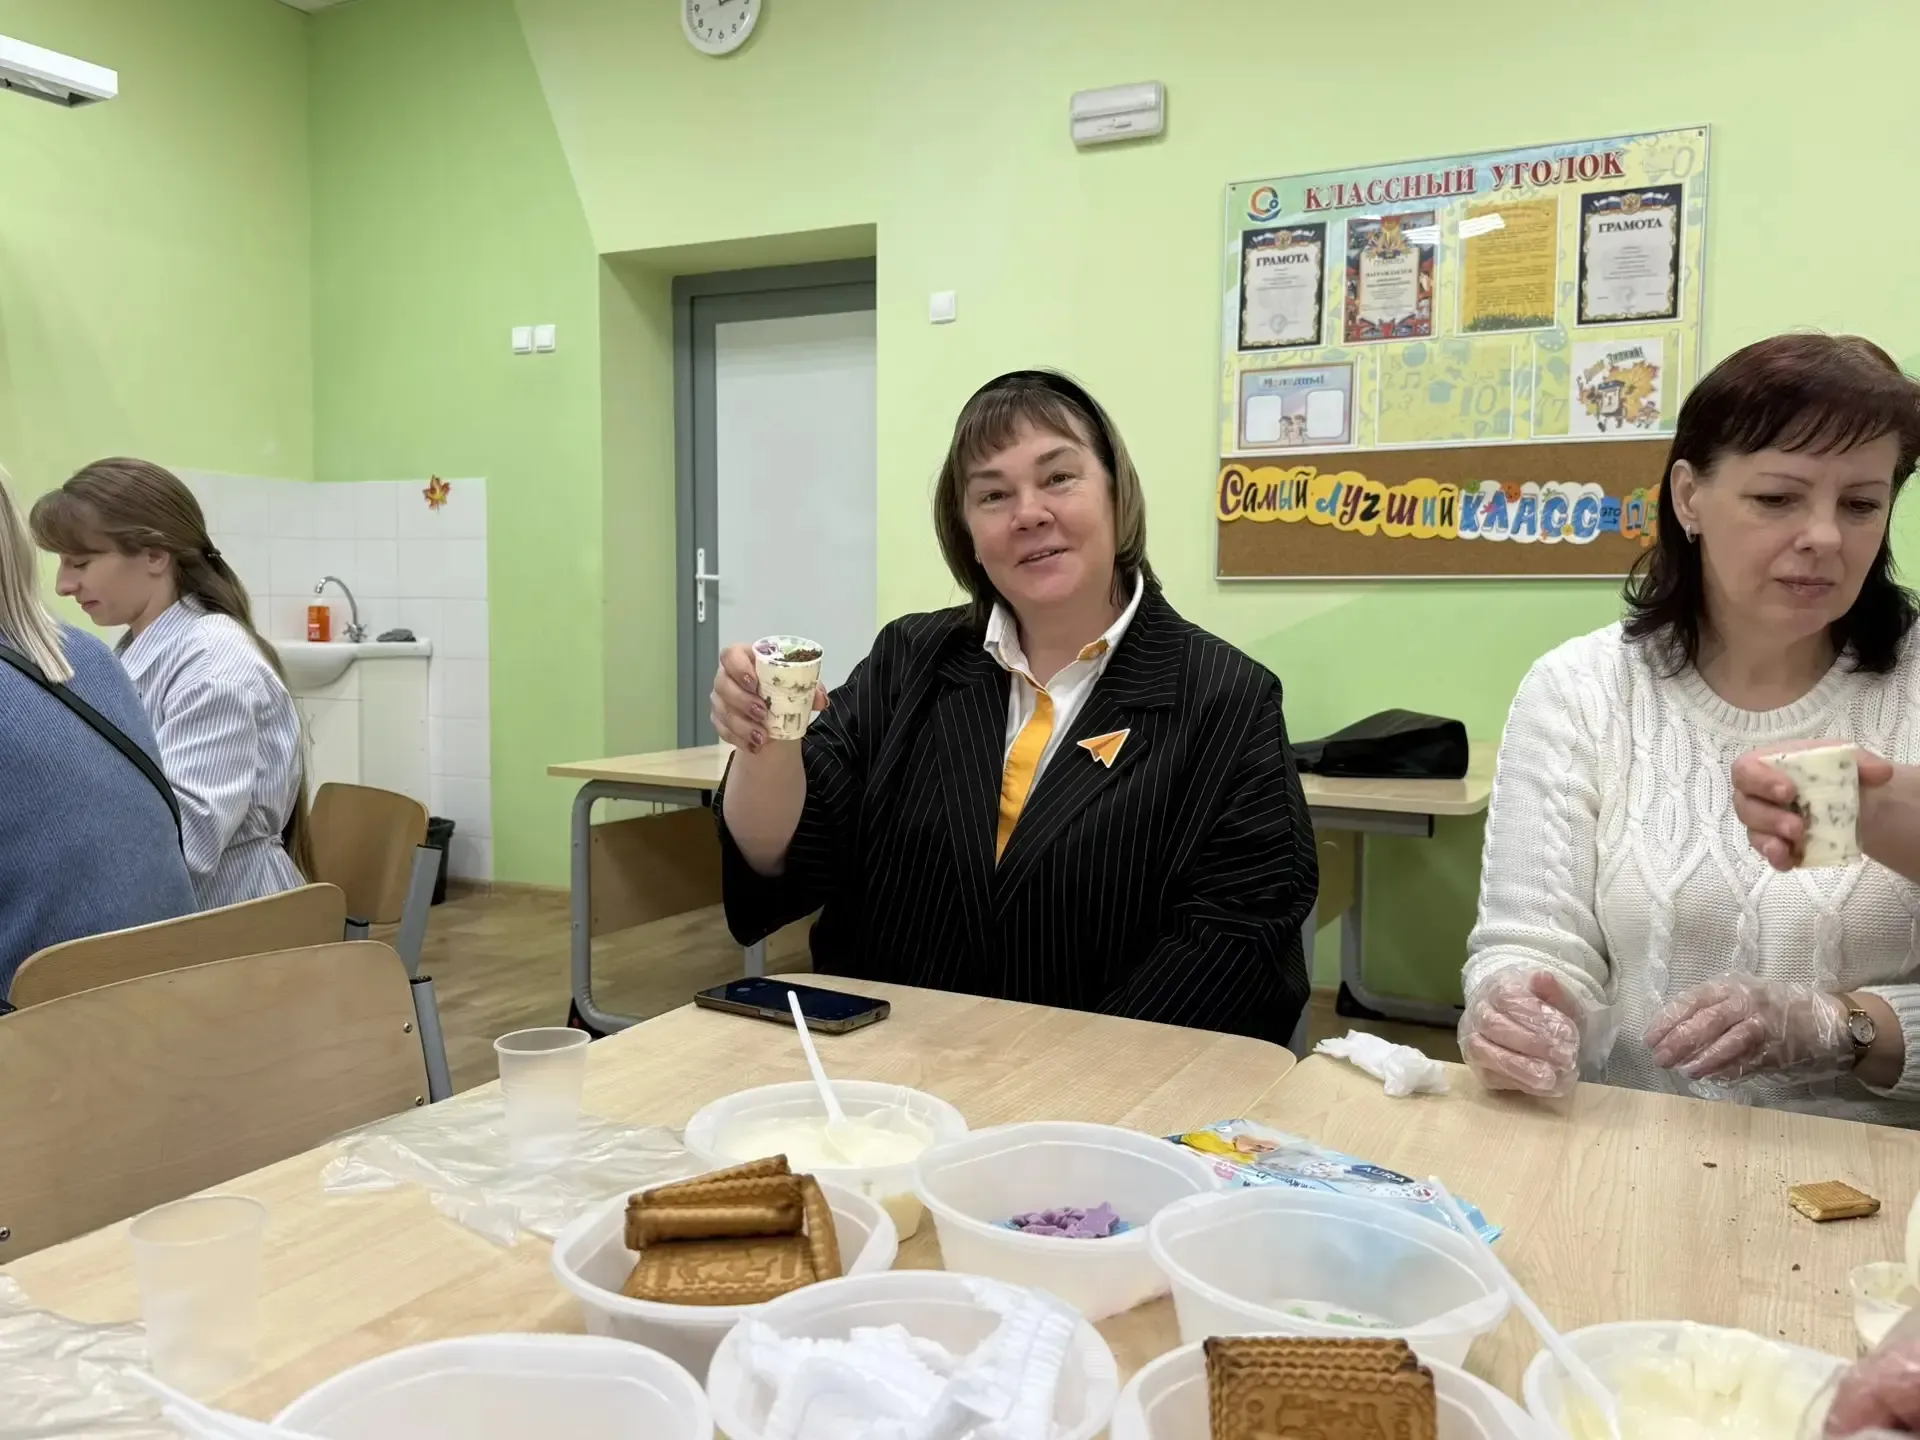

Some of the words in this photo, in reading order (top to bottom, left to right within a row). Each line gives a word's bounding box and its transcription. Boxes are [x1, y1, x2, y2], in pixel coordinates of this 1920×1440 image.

[1303, 164, 1477, 212] КЛАССНЫЙ
[1490, 151, 1625, 191] УГОЛОК
[1598, 218, 1664, 233] ГРАМОТА
[1256, 253, 1310, 267] ГРАМОТА
[1220, 470, 1310, 516] Самый
[1458, 490, 1599, 539] КЛАСС
[1359, 1166, 1405, 1183] AURA
